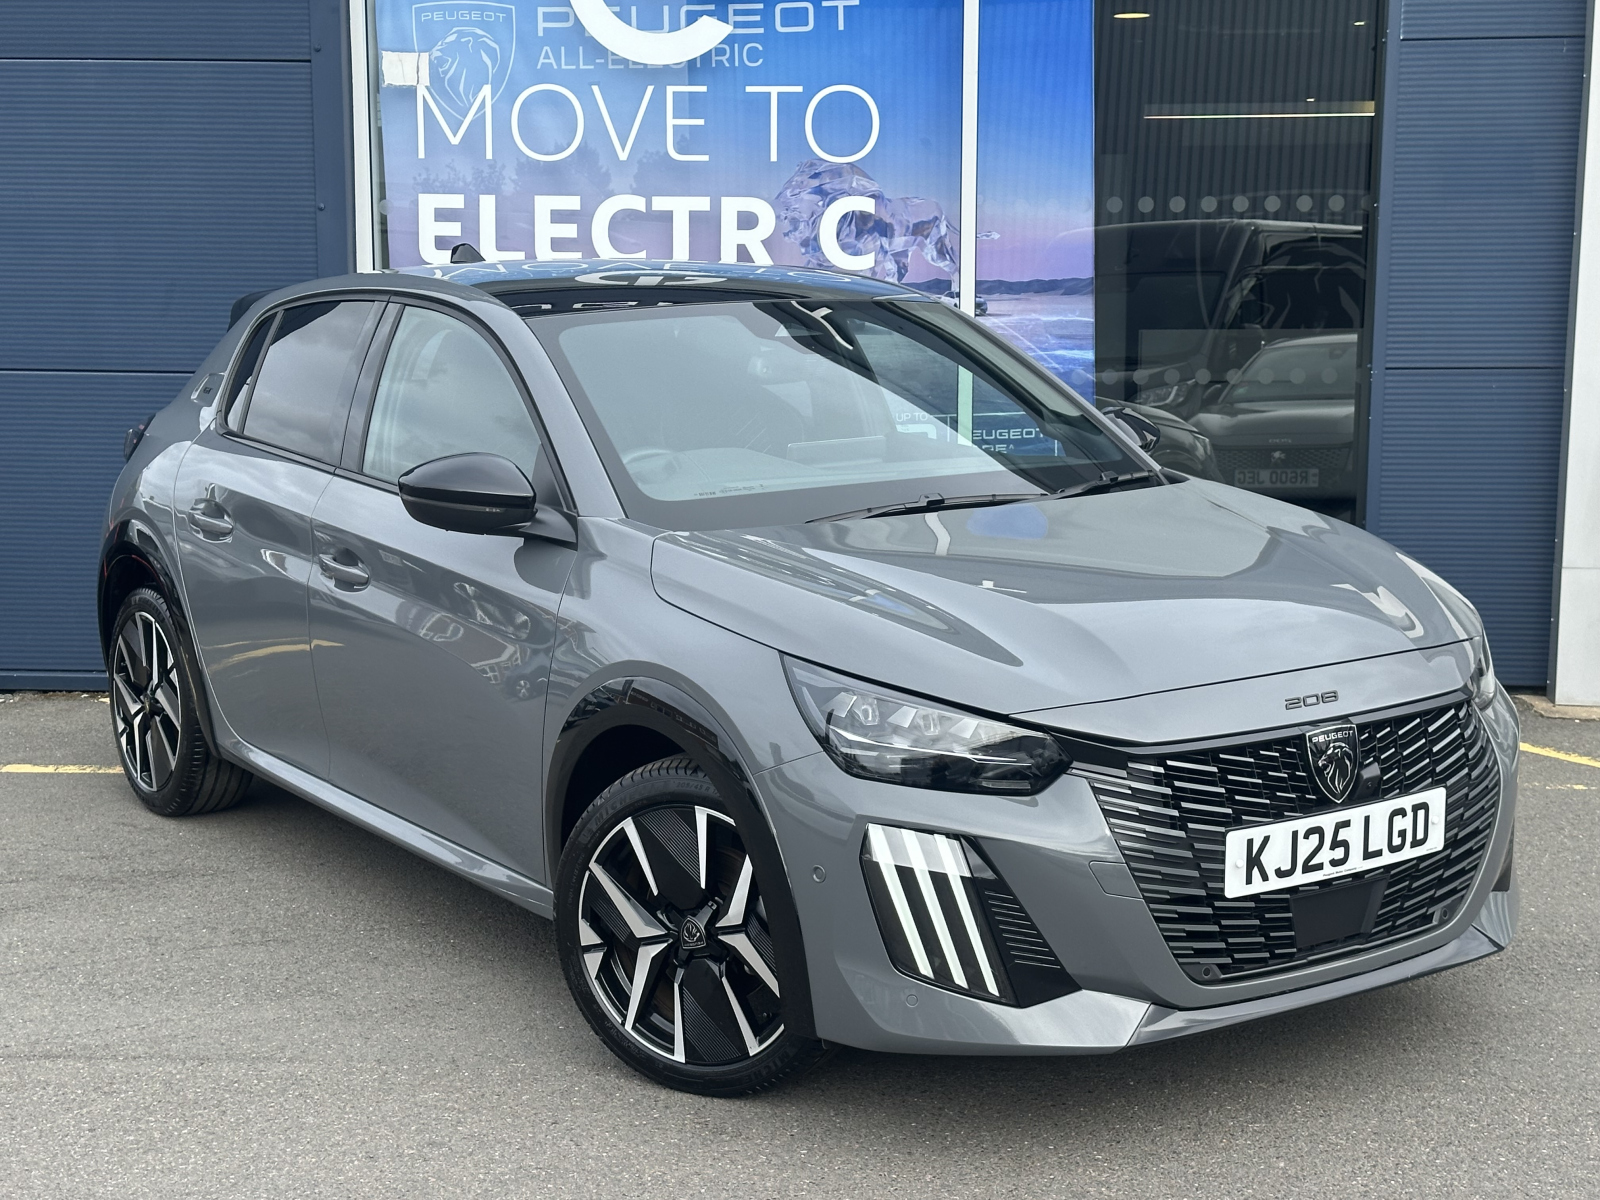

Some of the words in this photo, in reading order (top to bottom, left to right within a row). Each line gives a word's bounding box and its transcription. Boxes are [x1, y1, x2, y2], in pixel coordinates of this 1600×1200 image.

[421, 11, 507, 23] PEUGEOT
[416, 83, 708, 162] MOVE
[745, 84, 880, 163] TO
[895, 413, 911, 422] UP
[913, 412, 928, 422] TO
[1284, 690, 1339, 711] 208
[1311, 730, 1354, 743] PEUGEOT
[1245, 819, 1351, 885] KJ25
[1362, 801, 1430, 861] LGD
